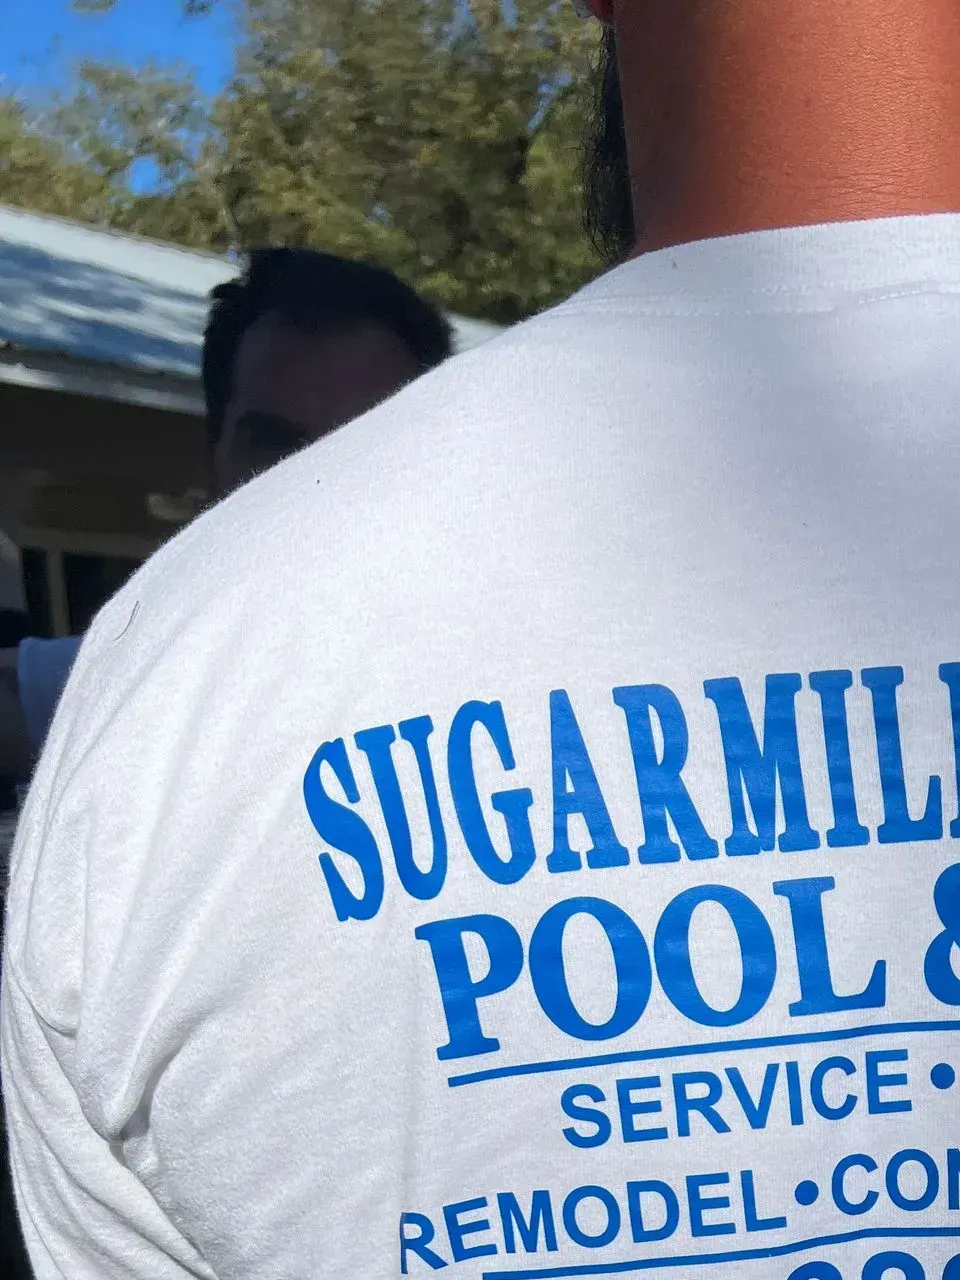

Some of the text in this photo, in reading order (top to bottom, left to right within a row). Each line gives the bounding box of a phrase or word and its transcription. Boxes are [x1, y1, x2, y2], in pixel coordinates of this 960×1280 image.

[415, 877, 886, 1060] POOL
[561, 1049, 912, 1148] SERVICE
[400, 1170, 787, 1273] REMODEL
